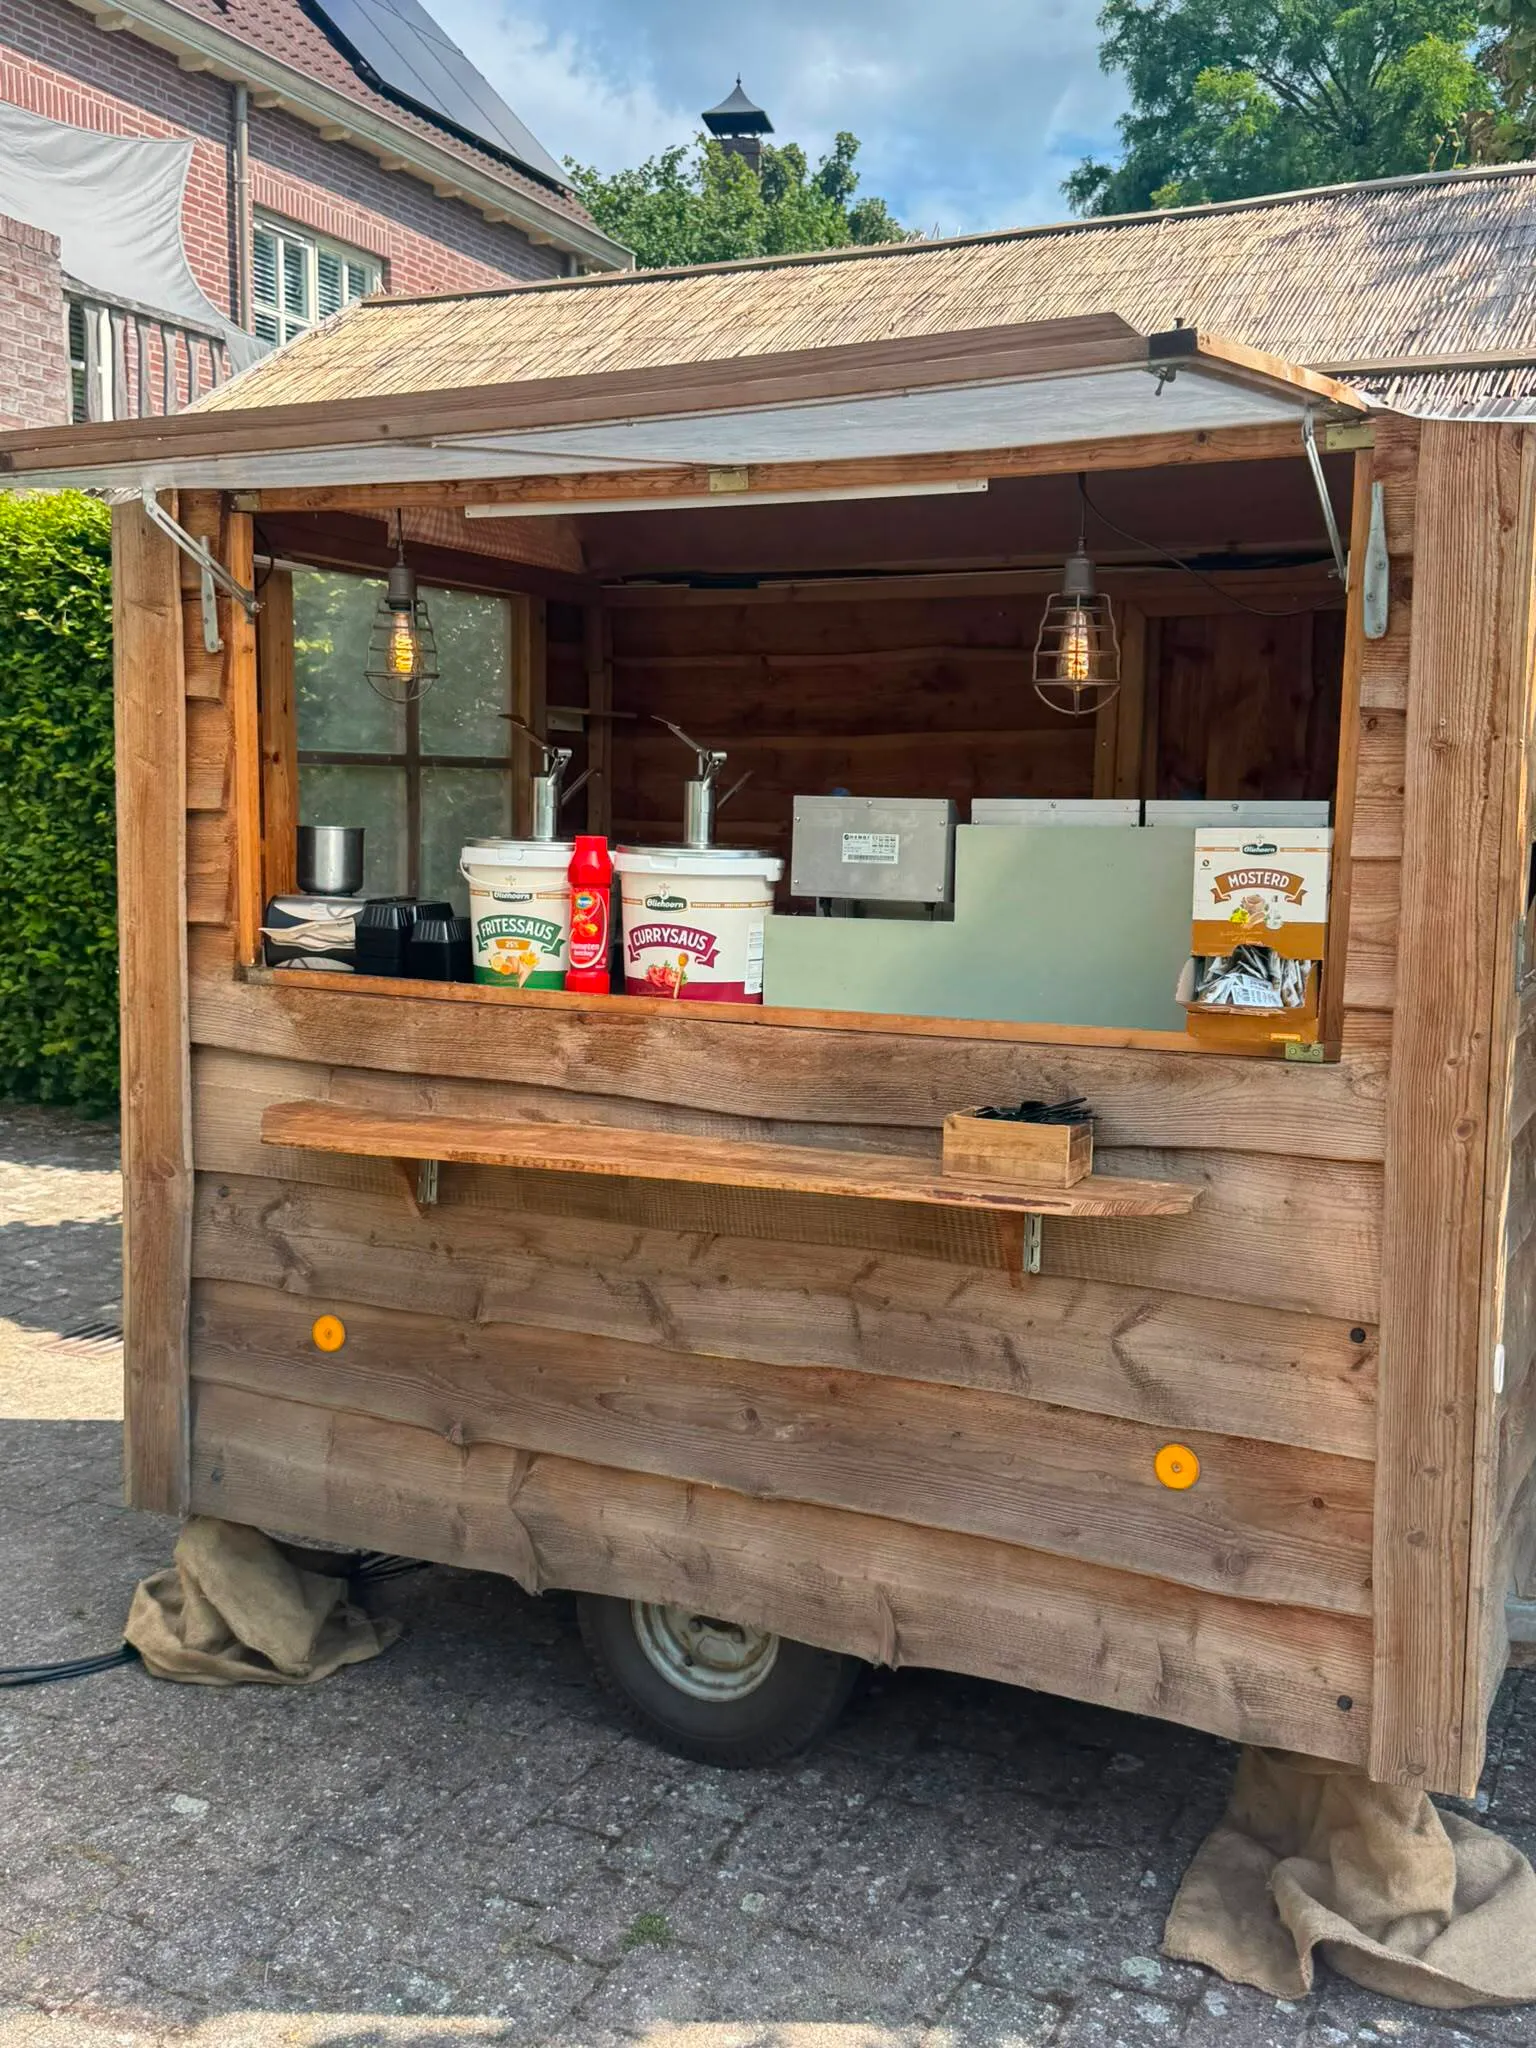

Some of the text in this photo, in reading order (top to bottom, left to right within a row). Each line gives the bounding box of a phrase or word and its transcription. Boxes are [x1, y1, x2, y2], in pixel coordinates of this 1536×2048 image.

[1227, 871, 1290, 888] MOSTERD
[481, 918, 554, 940] FRITESSAUS
[632, 927, 708, 951] CURRYSAUS
